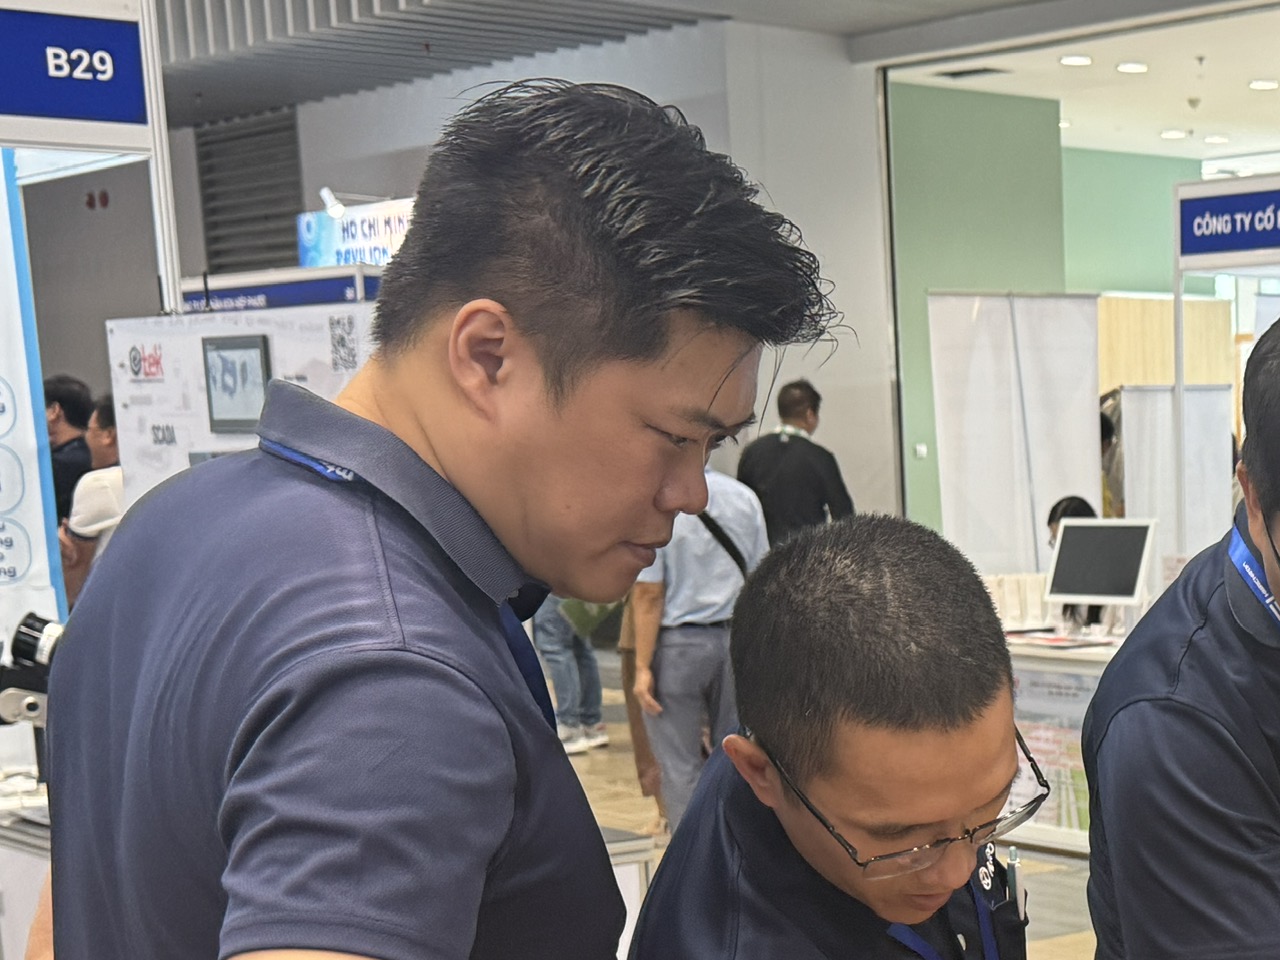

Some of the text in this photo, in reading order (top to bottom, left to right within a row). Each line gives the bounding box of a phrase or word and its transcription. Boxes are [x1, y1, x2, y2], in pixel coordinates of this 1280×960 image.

[46, 46, 114, 81] B29
[1193, 211, 1232, 236] CÔNG
[1234, 211, 1252, 232] TY
